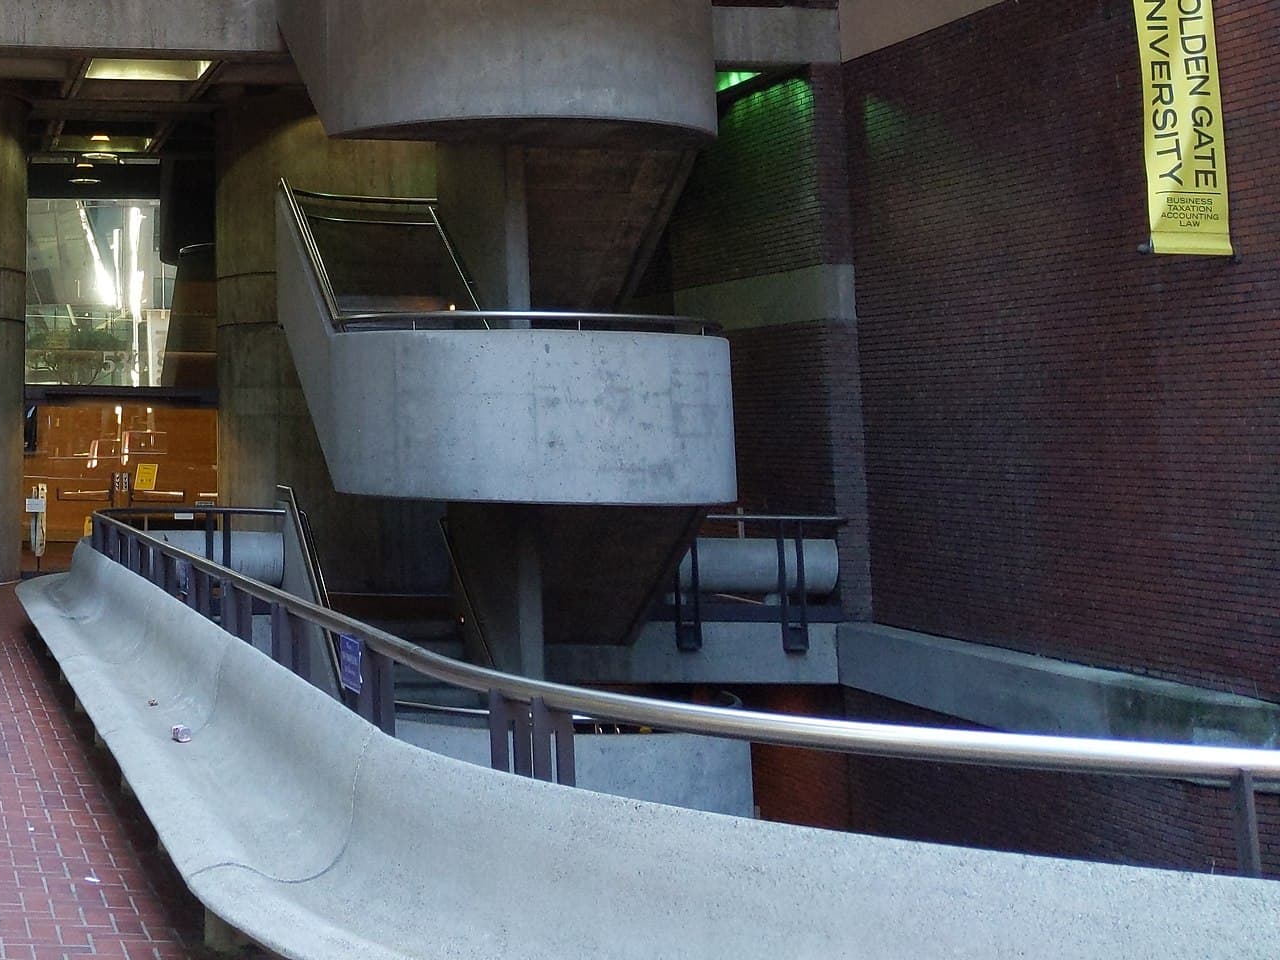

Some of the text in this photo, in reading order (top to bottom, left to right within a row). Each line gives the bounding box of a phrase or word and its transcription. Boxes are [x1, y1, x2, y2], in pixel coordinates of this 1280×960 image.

[1190, 106, 1217, 189] GATE
[1166, 197, 1213, 205] BUSINESS
[1167, 205, 1213, 213] TAXATION
[1161, 212, 1220, 221] ACCOUNTING
